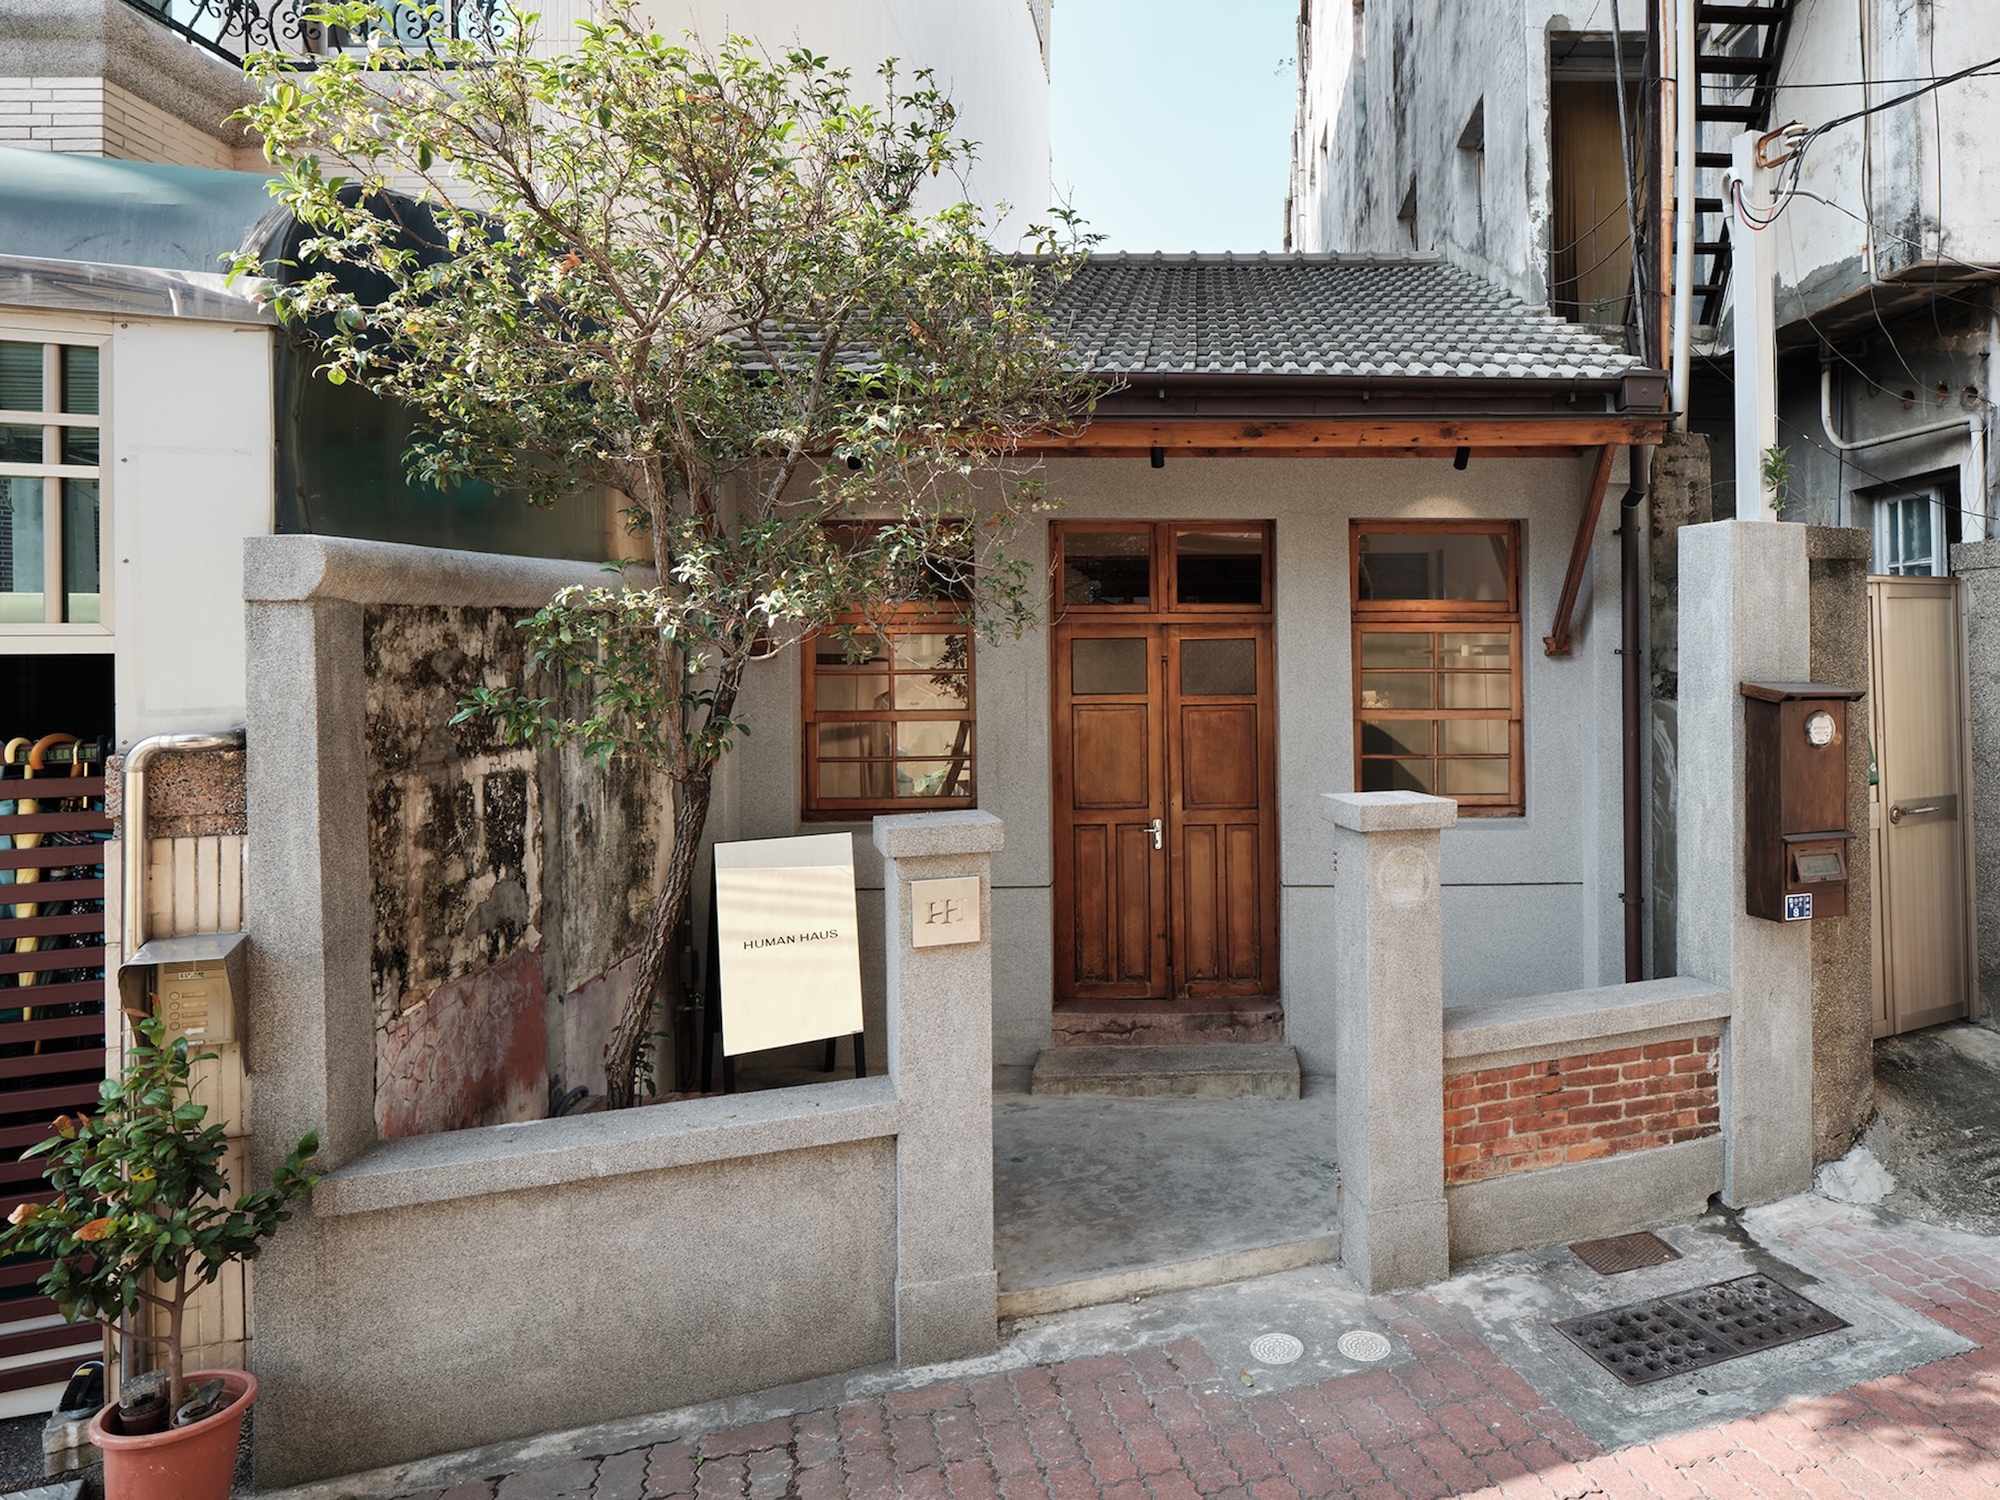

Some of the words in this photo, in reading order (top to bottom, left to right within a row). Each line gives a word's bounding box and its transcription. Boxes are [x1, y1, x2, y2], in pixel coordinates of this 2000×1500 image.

[1793, 907, 1799, 917] 8
[743, 934, 796, 950] HUMAN
[800, 929, 839, 943] HAUS
